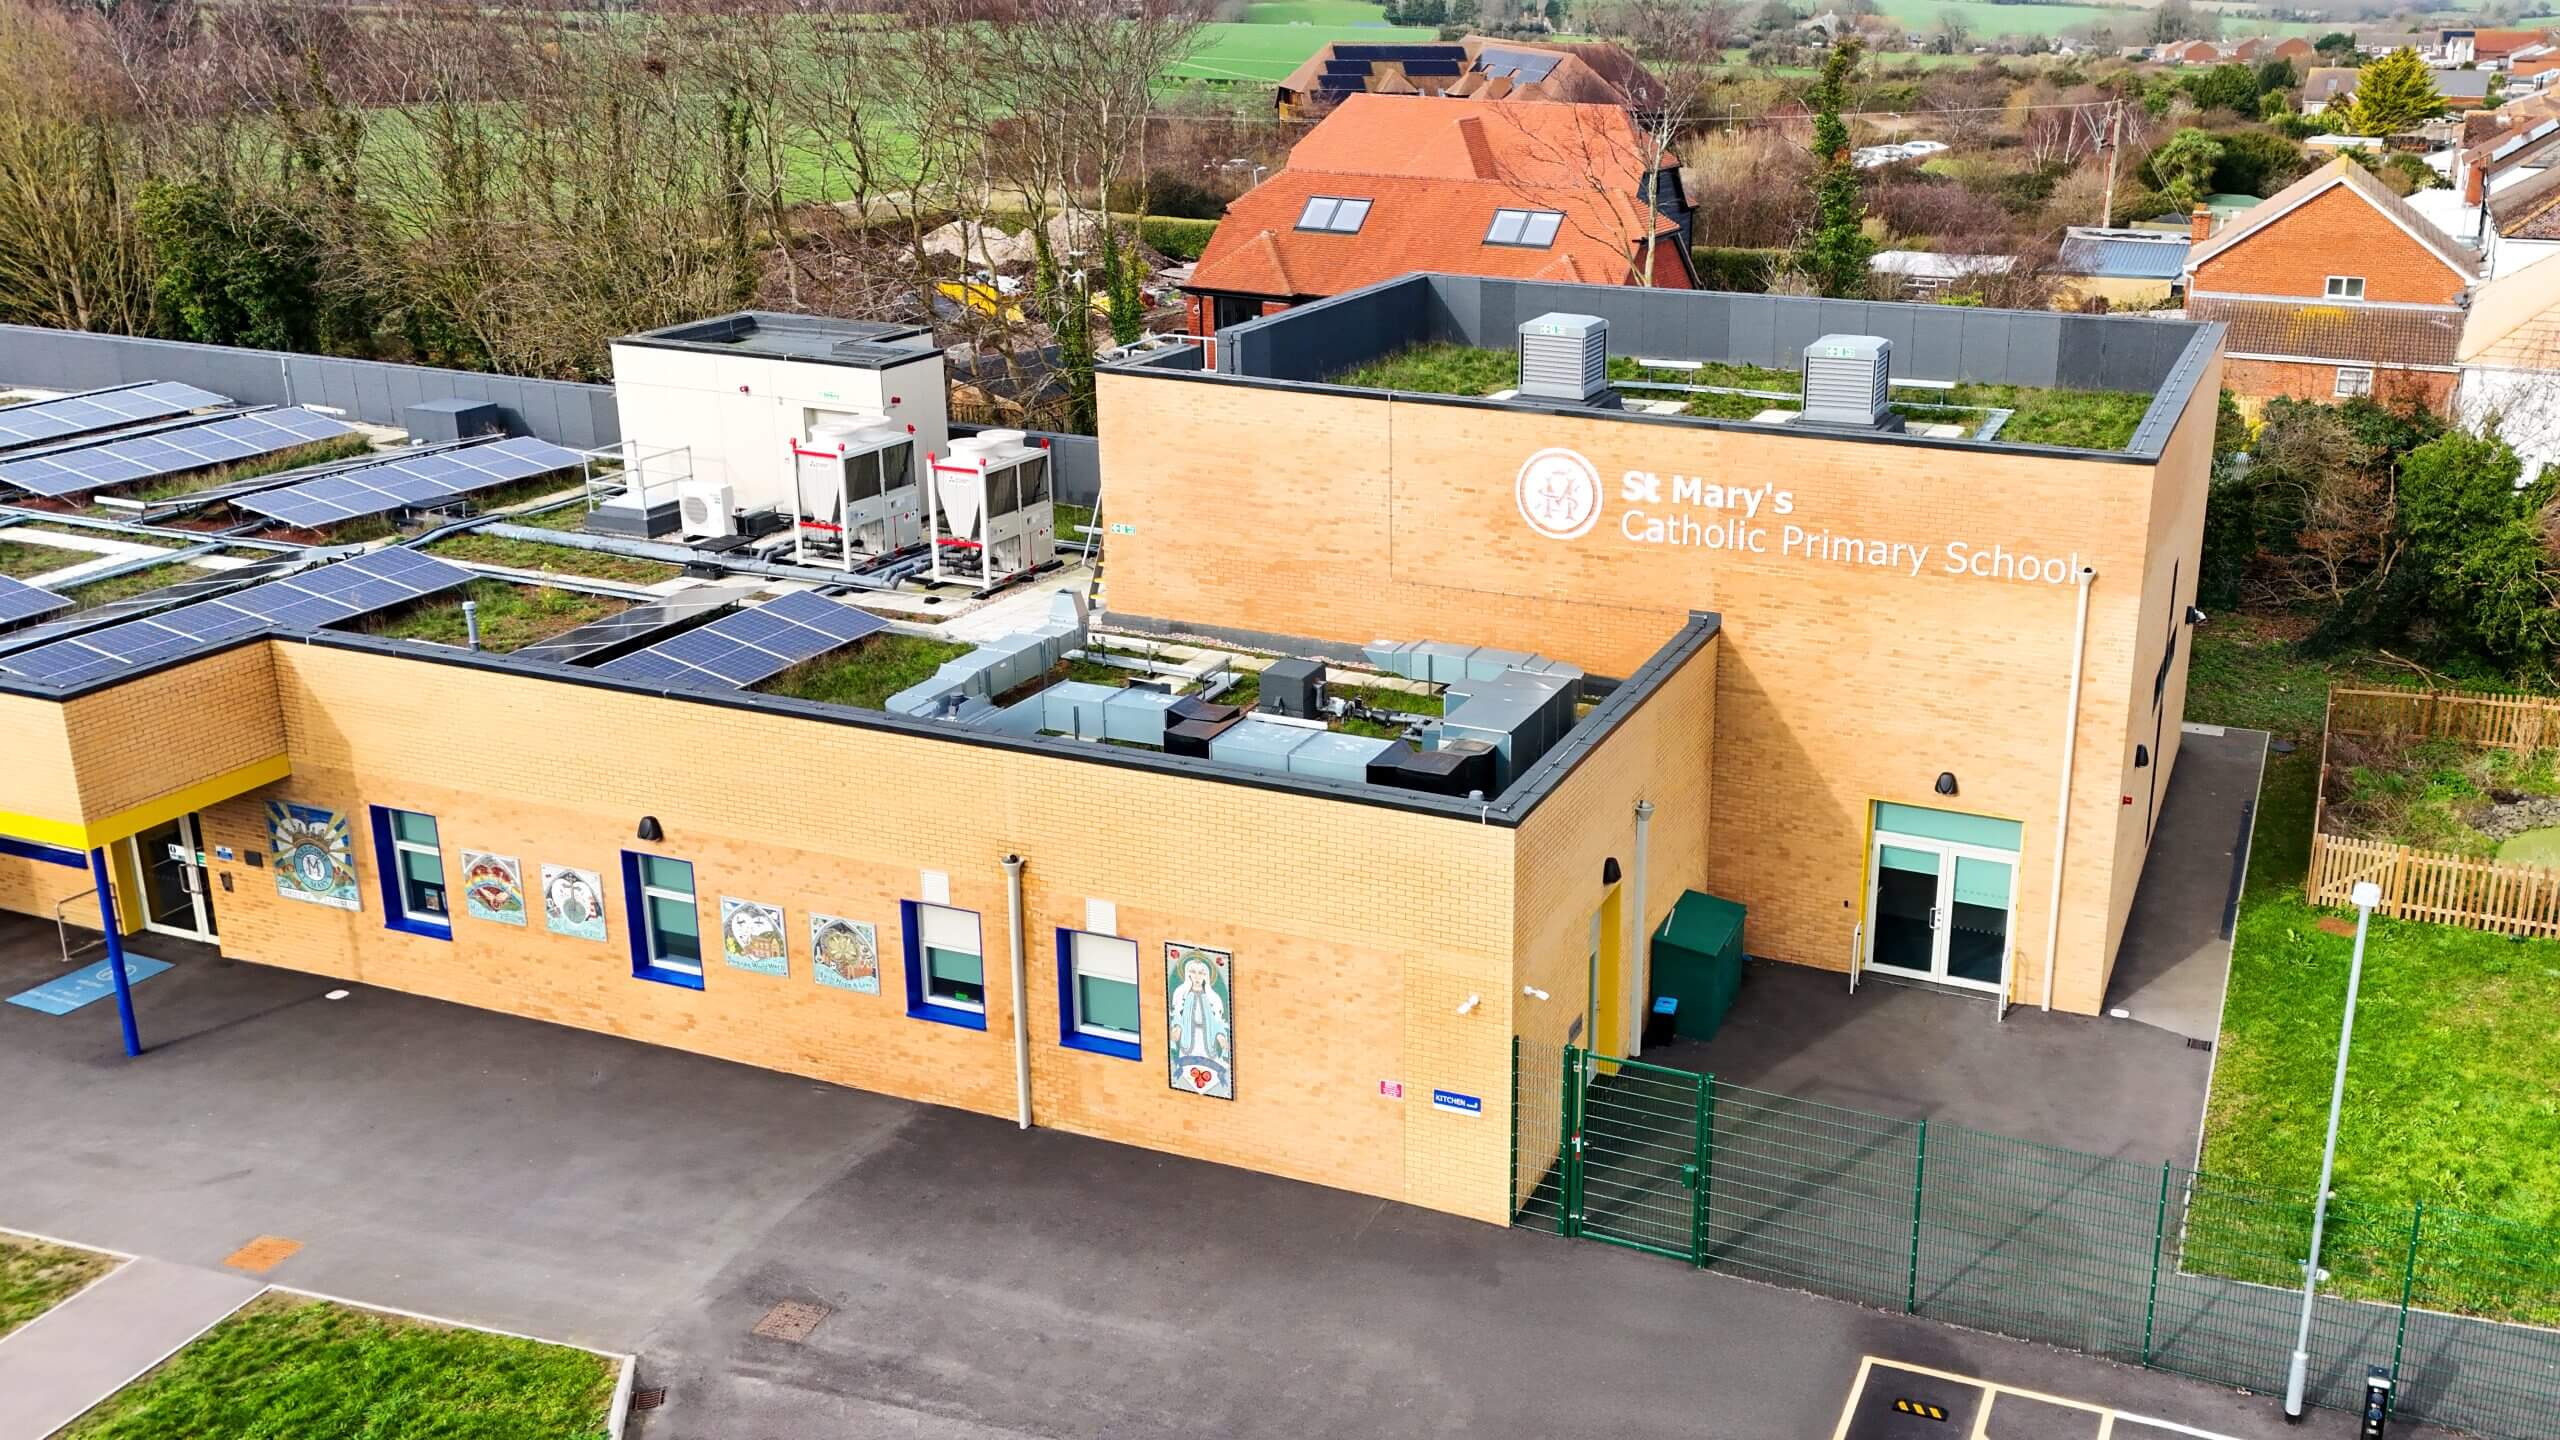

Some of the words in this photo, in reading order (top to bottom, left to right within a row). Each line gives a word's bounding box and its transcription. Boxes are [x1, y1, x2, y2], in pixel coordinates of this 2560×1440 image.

[1621, 470, 1661, 504] St
[1672, 475, 1795, 519] Mary's
[1620, 509, 1767, 554] Catholic
[1782, 525, 1930, 578] Primary
[1944, 541, 2079, 586] School
[1435, 1094, 1466, 1106] KITCHEN
